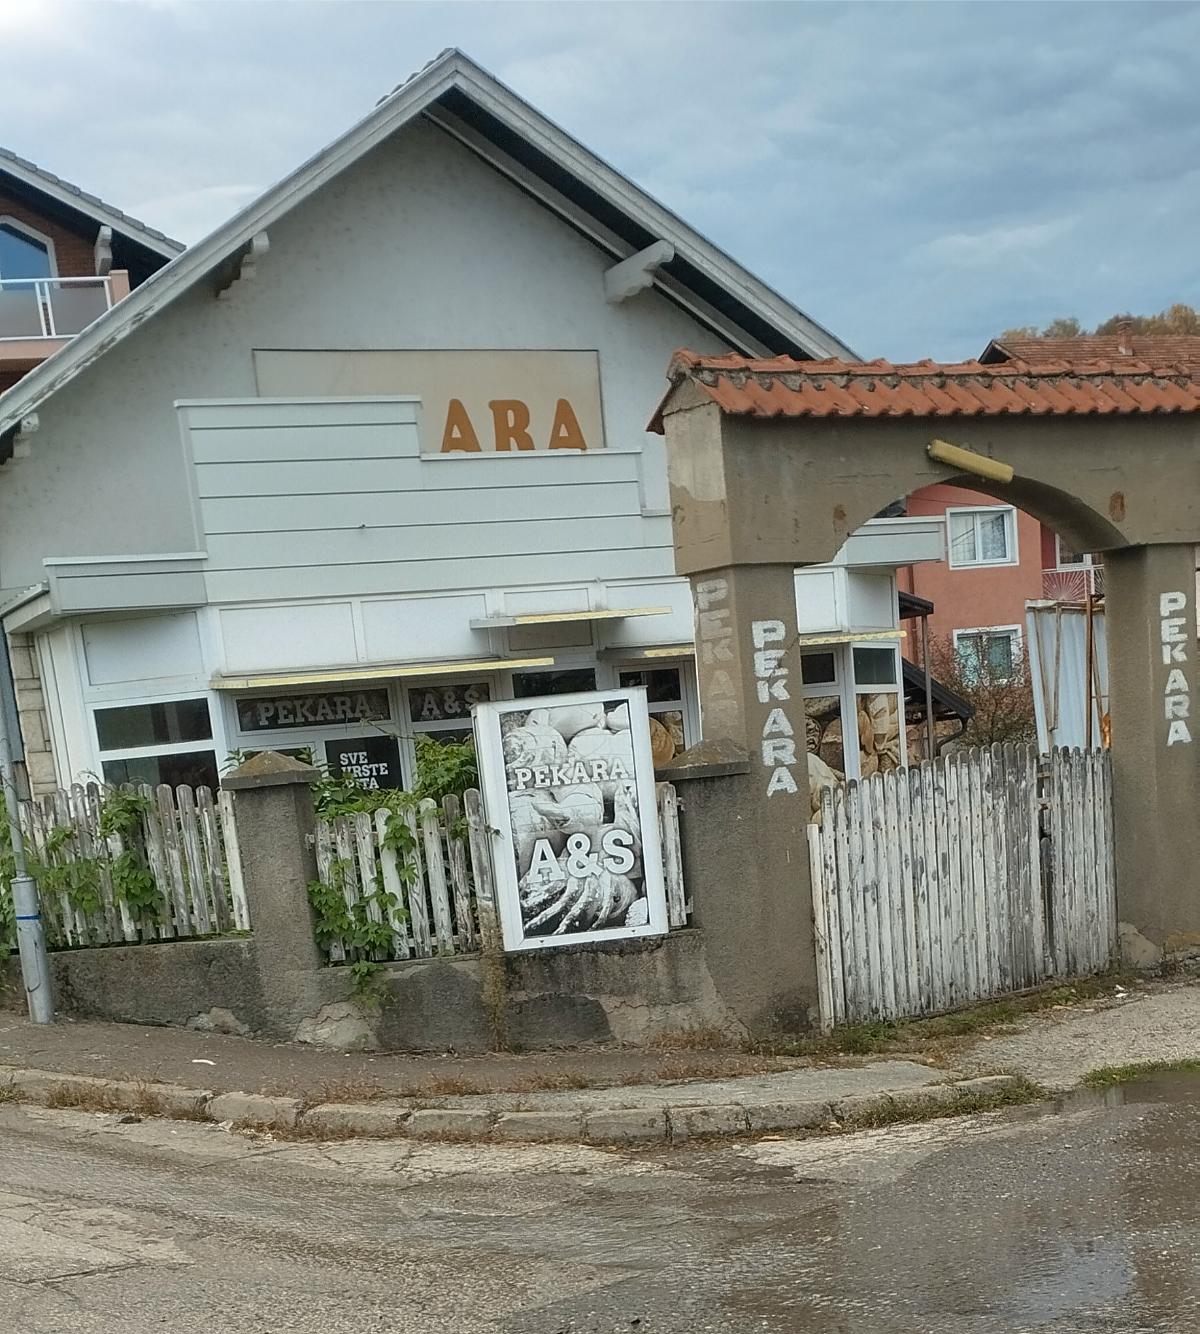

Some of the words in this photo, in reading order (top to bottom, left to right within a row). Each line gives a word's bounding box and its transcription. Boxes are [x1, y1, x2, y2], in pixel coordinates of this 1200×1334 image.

[1160, 591, 1192, 746] PEKARA
[256, 694, 374, 727] PEKARA
[752, 620, 798, 797] PEKARA
[340, 751, 368, 765] SVE
[514, 758, 629, 790] PEKARA
[526, 829, 635, 884] A&S
